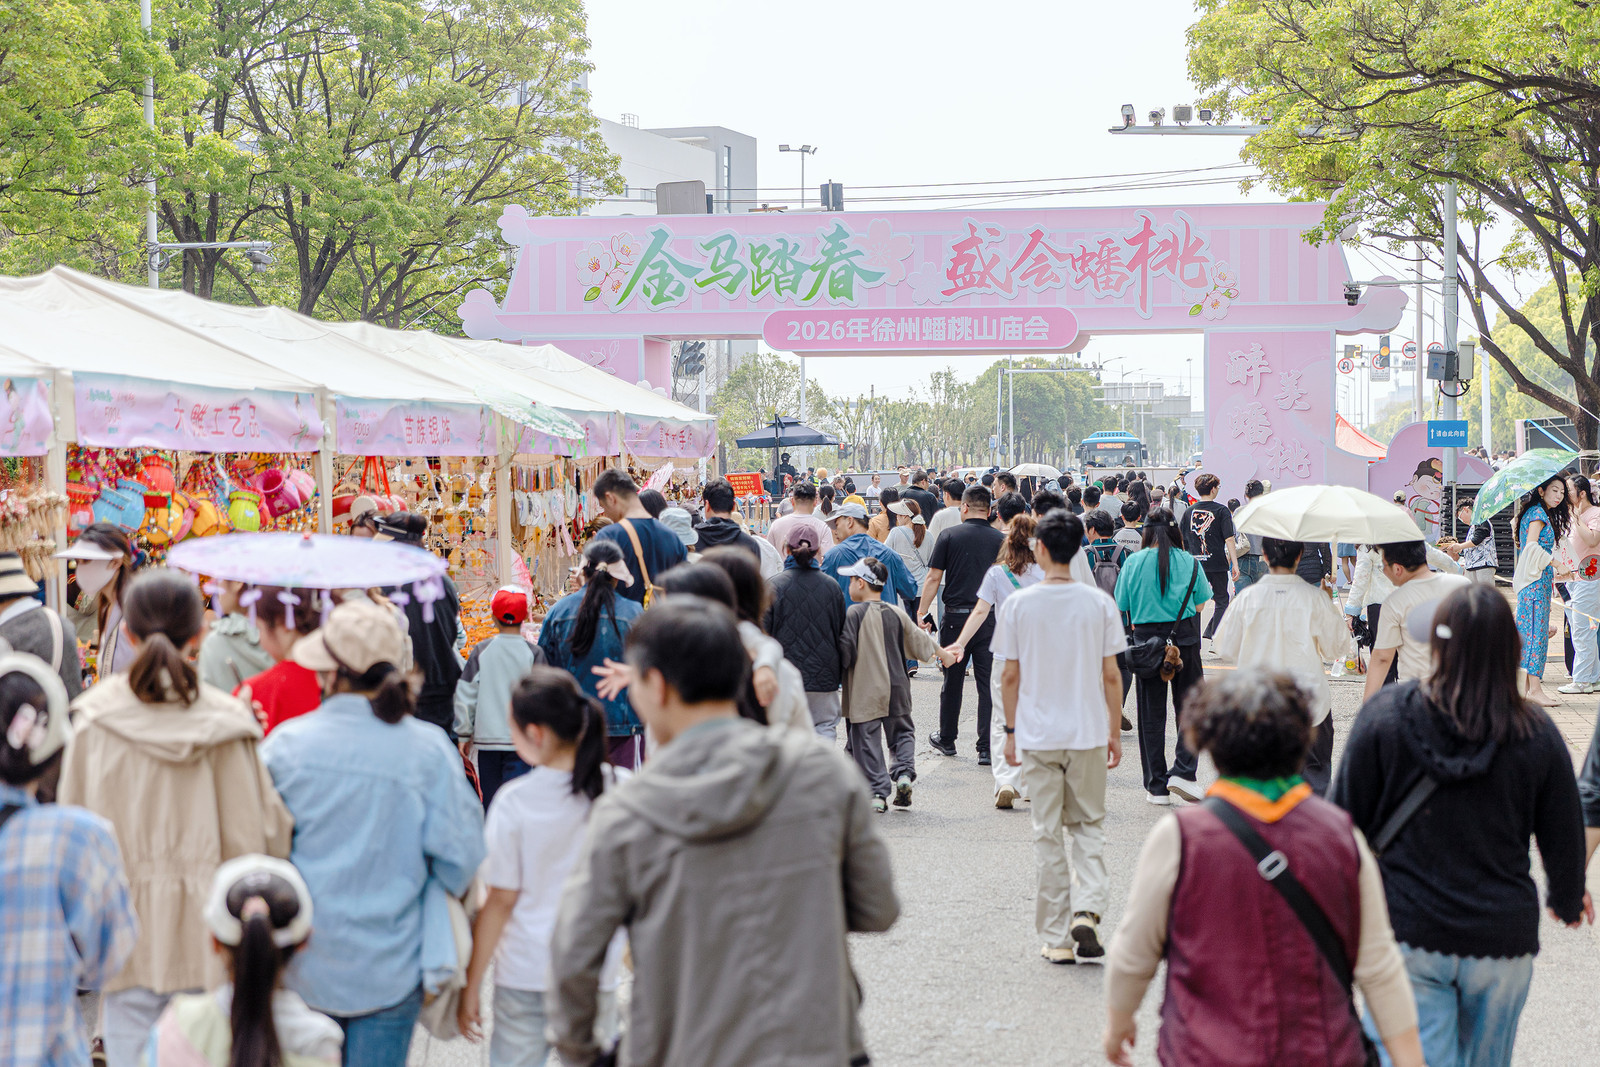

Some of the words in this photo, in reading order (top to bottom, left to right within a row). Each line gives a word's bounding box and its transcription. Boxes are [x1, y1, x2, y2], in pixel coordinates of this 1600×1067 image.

[616, 222, 887, 307] 金马踏春
[941, 214, 1211, 314] 盛会蟠桃
[787, 315, 1050, 343] 2026年徐州蟠桃山庙会
[404, 415, 451, 445] 苗族银饰
[1436, 430, 1466, 438] 请由此向前
